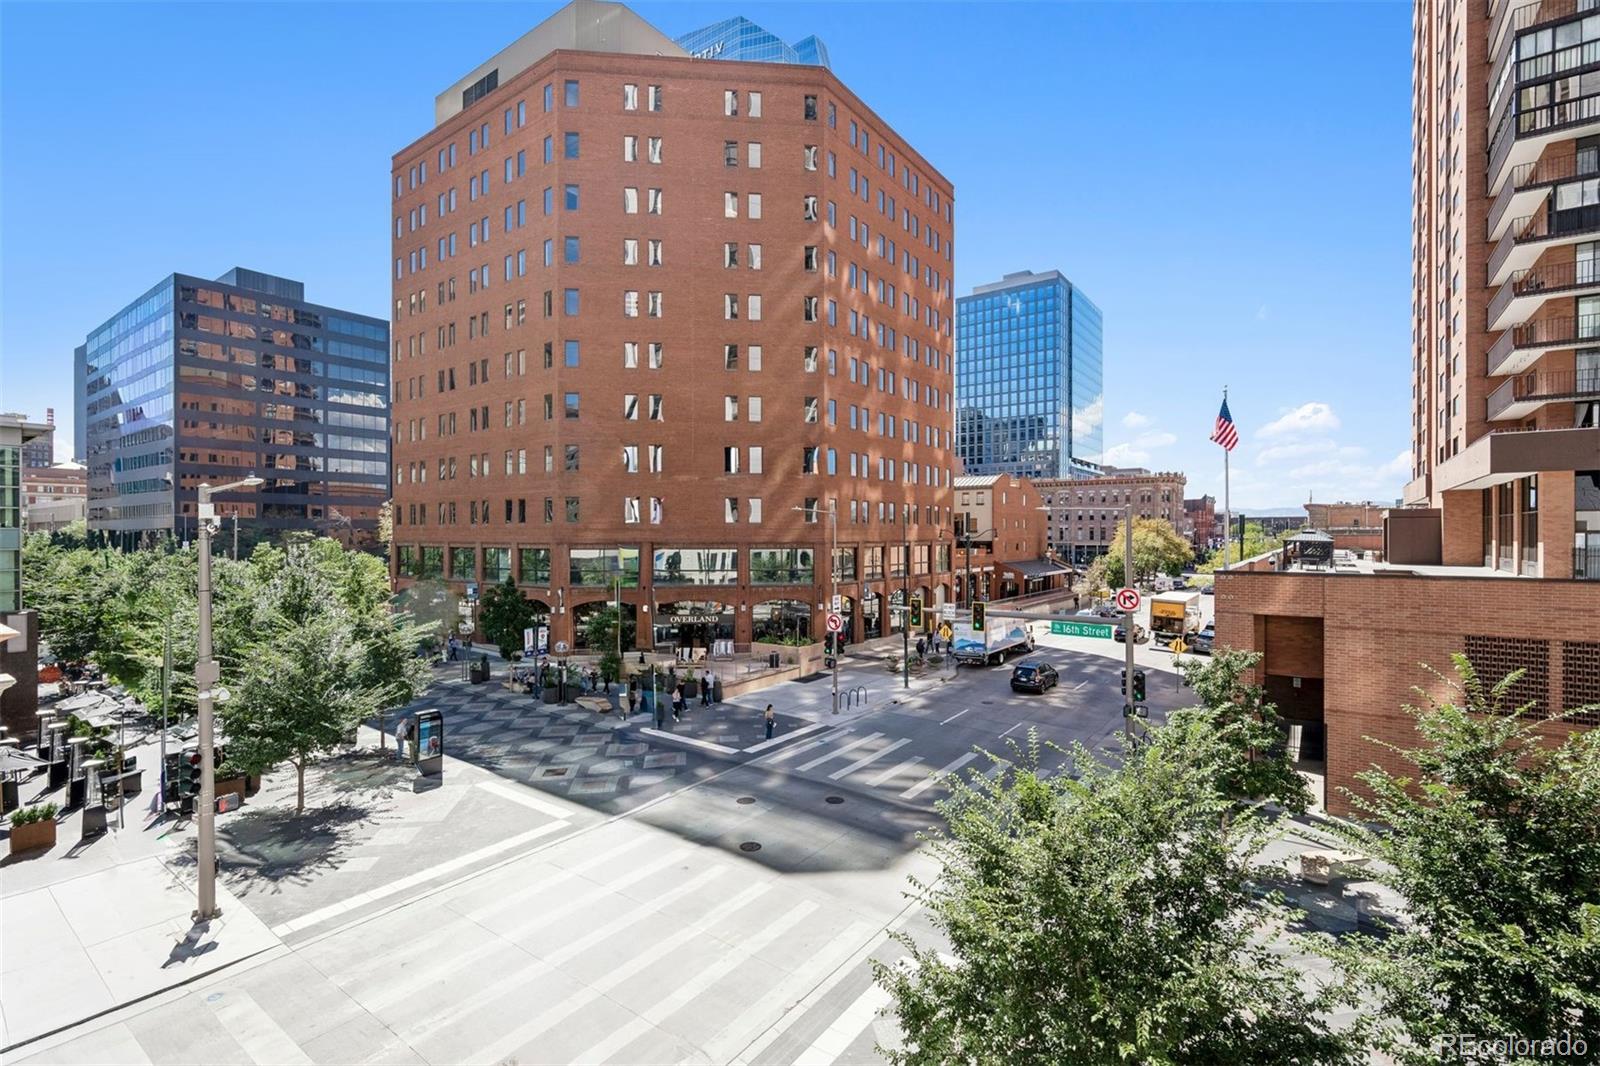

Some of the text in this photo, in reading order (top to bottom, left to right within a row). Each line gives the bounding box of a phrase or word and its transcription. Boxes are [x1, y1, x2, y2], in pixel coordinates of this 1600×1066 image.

[670, 615, 719, 623] OVERLAND
[1062, 624, 1109, 637] 16th Street
